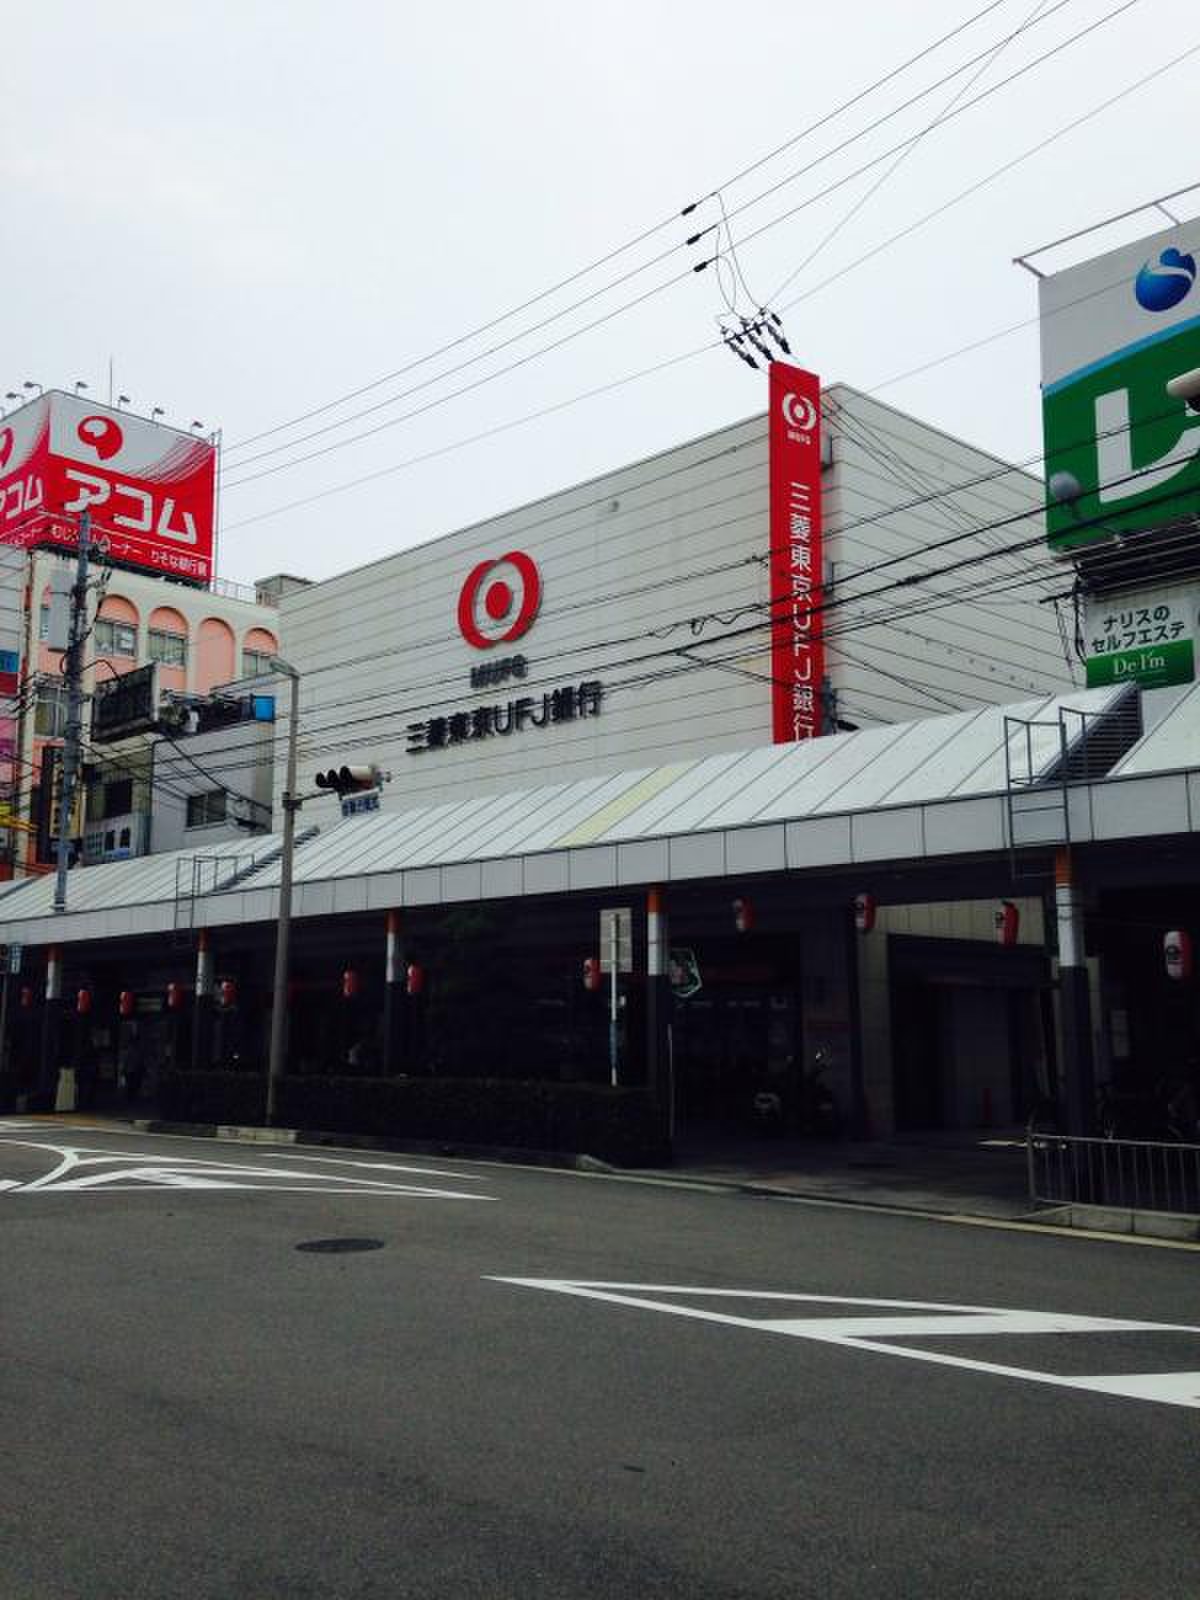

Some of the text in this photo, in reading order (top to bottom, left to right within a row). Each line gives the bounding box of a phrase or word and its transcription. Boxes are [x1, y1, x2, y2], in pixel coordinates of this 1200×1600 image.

[64, 468, 197, 545] アコム
[1091, 621, 1185, 654] セルフエステ
[1103, 605, 1170, 634] ナリスの
[405, 680, 605, 754] 三菱東京UFJ銀行
